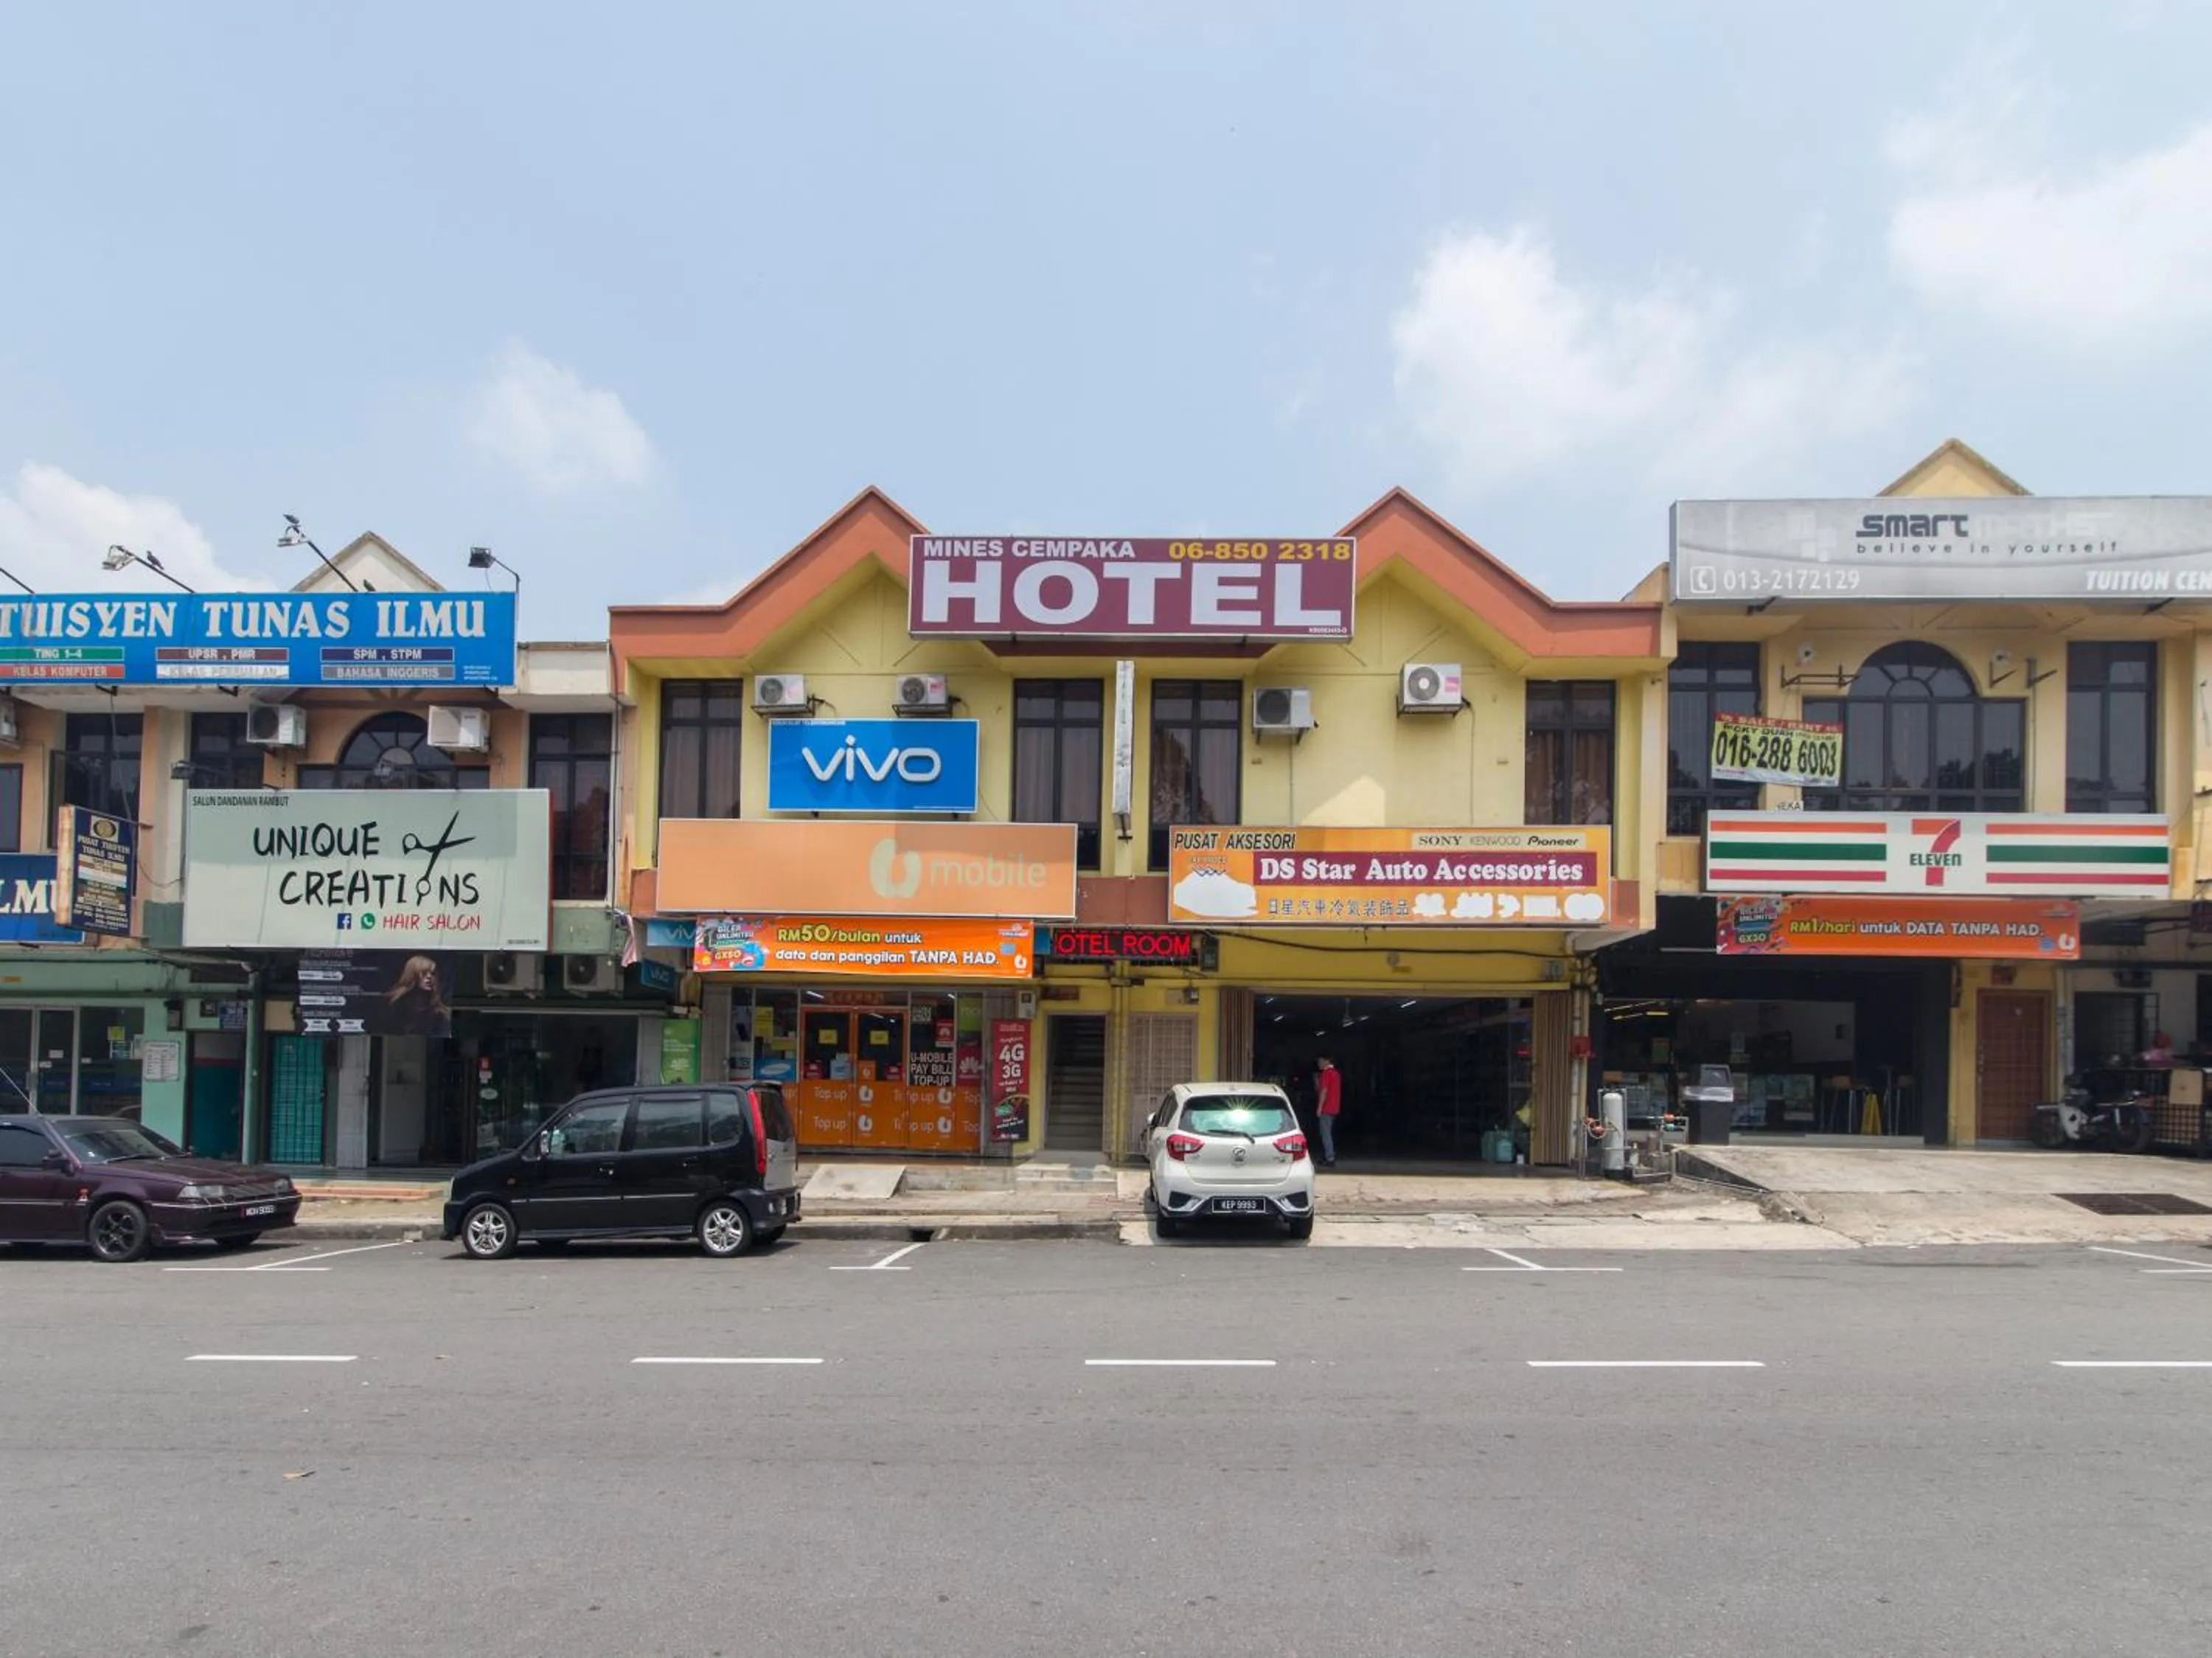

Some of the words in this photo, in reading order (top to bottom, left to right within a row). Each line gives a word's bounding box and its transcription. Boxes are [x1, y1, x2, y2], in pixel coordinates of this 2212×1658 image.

[1856, 514, 1968, 538] smart
[923, 540, 1004, 558] MINES
[1011, 540, 1135, 558] CEMPAKA
[1168, 542, 1267, 560] 06-850
[1277, 543, 1352, 561] 2318
[1857, 542, 1952, 554] believe
[1969, 542, 1990, 554] in
[2008, 541, 2117, 555] yourself
[1723, 569, 1860, 591] 013-2172129
[2085, 569, 2170, 591] TUITION
[921, 560, 1342, 626] HOTEL
[0, 601, 178, 638] TUISYEN
[203, 600, 351, 639] TUNAS
[376, 600, 486, 638] ILMU
[35, 648, 60, 659] TING
[64, 648, 83, 659] 1-4
[188, 648, 218, 659] UPSR
[231, 648, 256, 659] PMR
[353, 649, 377, 659] SPM
[391, 649, 422, 660] STPM
[13, 665, 46, 676] KELAS
[51, 665, 108, 676] KOMPUTER
[337, 667, 382, 679] BAHASA
[387, 667, 439, 678] INGGERIS
[801, 735, 942, 782] vivo
[1716, 730, 1792, 772] 016-288
[1797, 740, 1837, 777] 6003
[253, 821, 381, 860] UNIQUE
[1174, 833, 1218, 850] PUSAT
[1225, 833, 1296, 850] AKSESORI
[1419, 836, 1462, 846] SONY
[1470, 836, 1521, 846] KENWOOD
[1527, 836, 1579, 846] Pioneer
[1912, 819, 1961, 886] 7
[928, 853, 1047, 887] mobile
[1260, 859, 1295, 880] DS
[1301, 859, 1355, 880] Star
[1365, 859, 1427, 880] Auto
[1433, 858, 1583, 881] Accessories
[383, 915, 420, 931] HAIR
[427, 915, 481, 931] SALON
[1790, 916, 1856, 933] RM1/hari
[1860, 921, 1902, 933] untuk
[1907, 922, 1944, 934] DATA
[1952, 923, 2000, 935] TANPA
[2006, 923, 2044, 936] HAD.
[778, 924, 880, 943] RM50/bulan
[885, 933, 922, 943] untuk
[1123, 934, 1191, 955] ROOM
[776, 949, 806, 960] data
[810, 950, 835, 961] dan
[839, 951, 905, 965] panggilan
[909, 950, 958, 964] TANPA
[962, 951, 1001, 965] HAD.
[911, 1052, 953, 1062] U-MOBILE
[999, 1044, 1025, 1062] 4G
[911, 1064, 928, 1074] PAY
[931, 1064, 952, 1074] BILL
[1002, 1064, 1021, 1078] 3G
[914, 1075, 950, 1086] TOP-UP
[814, 1086, 832, 1100] Top
[834, 1088, 848, 1100] up
[813, 1116, 831, 1130] Top
[832, 1118, 846, 1130] up
